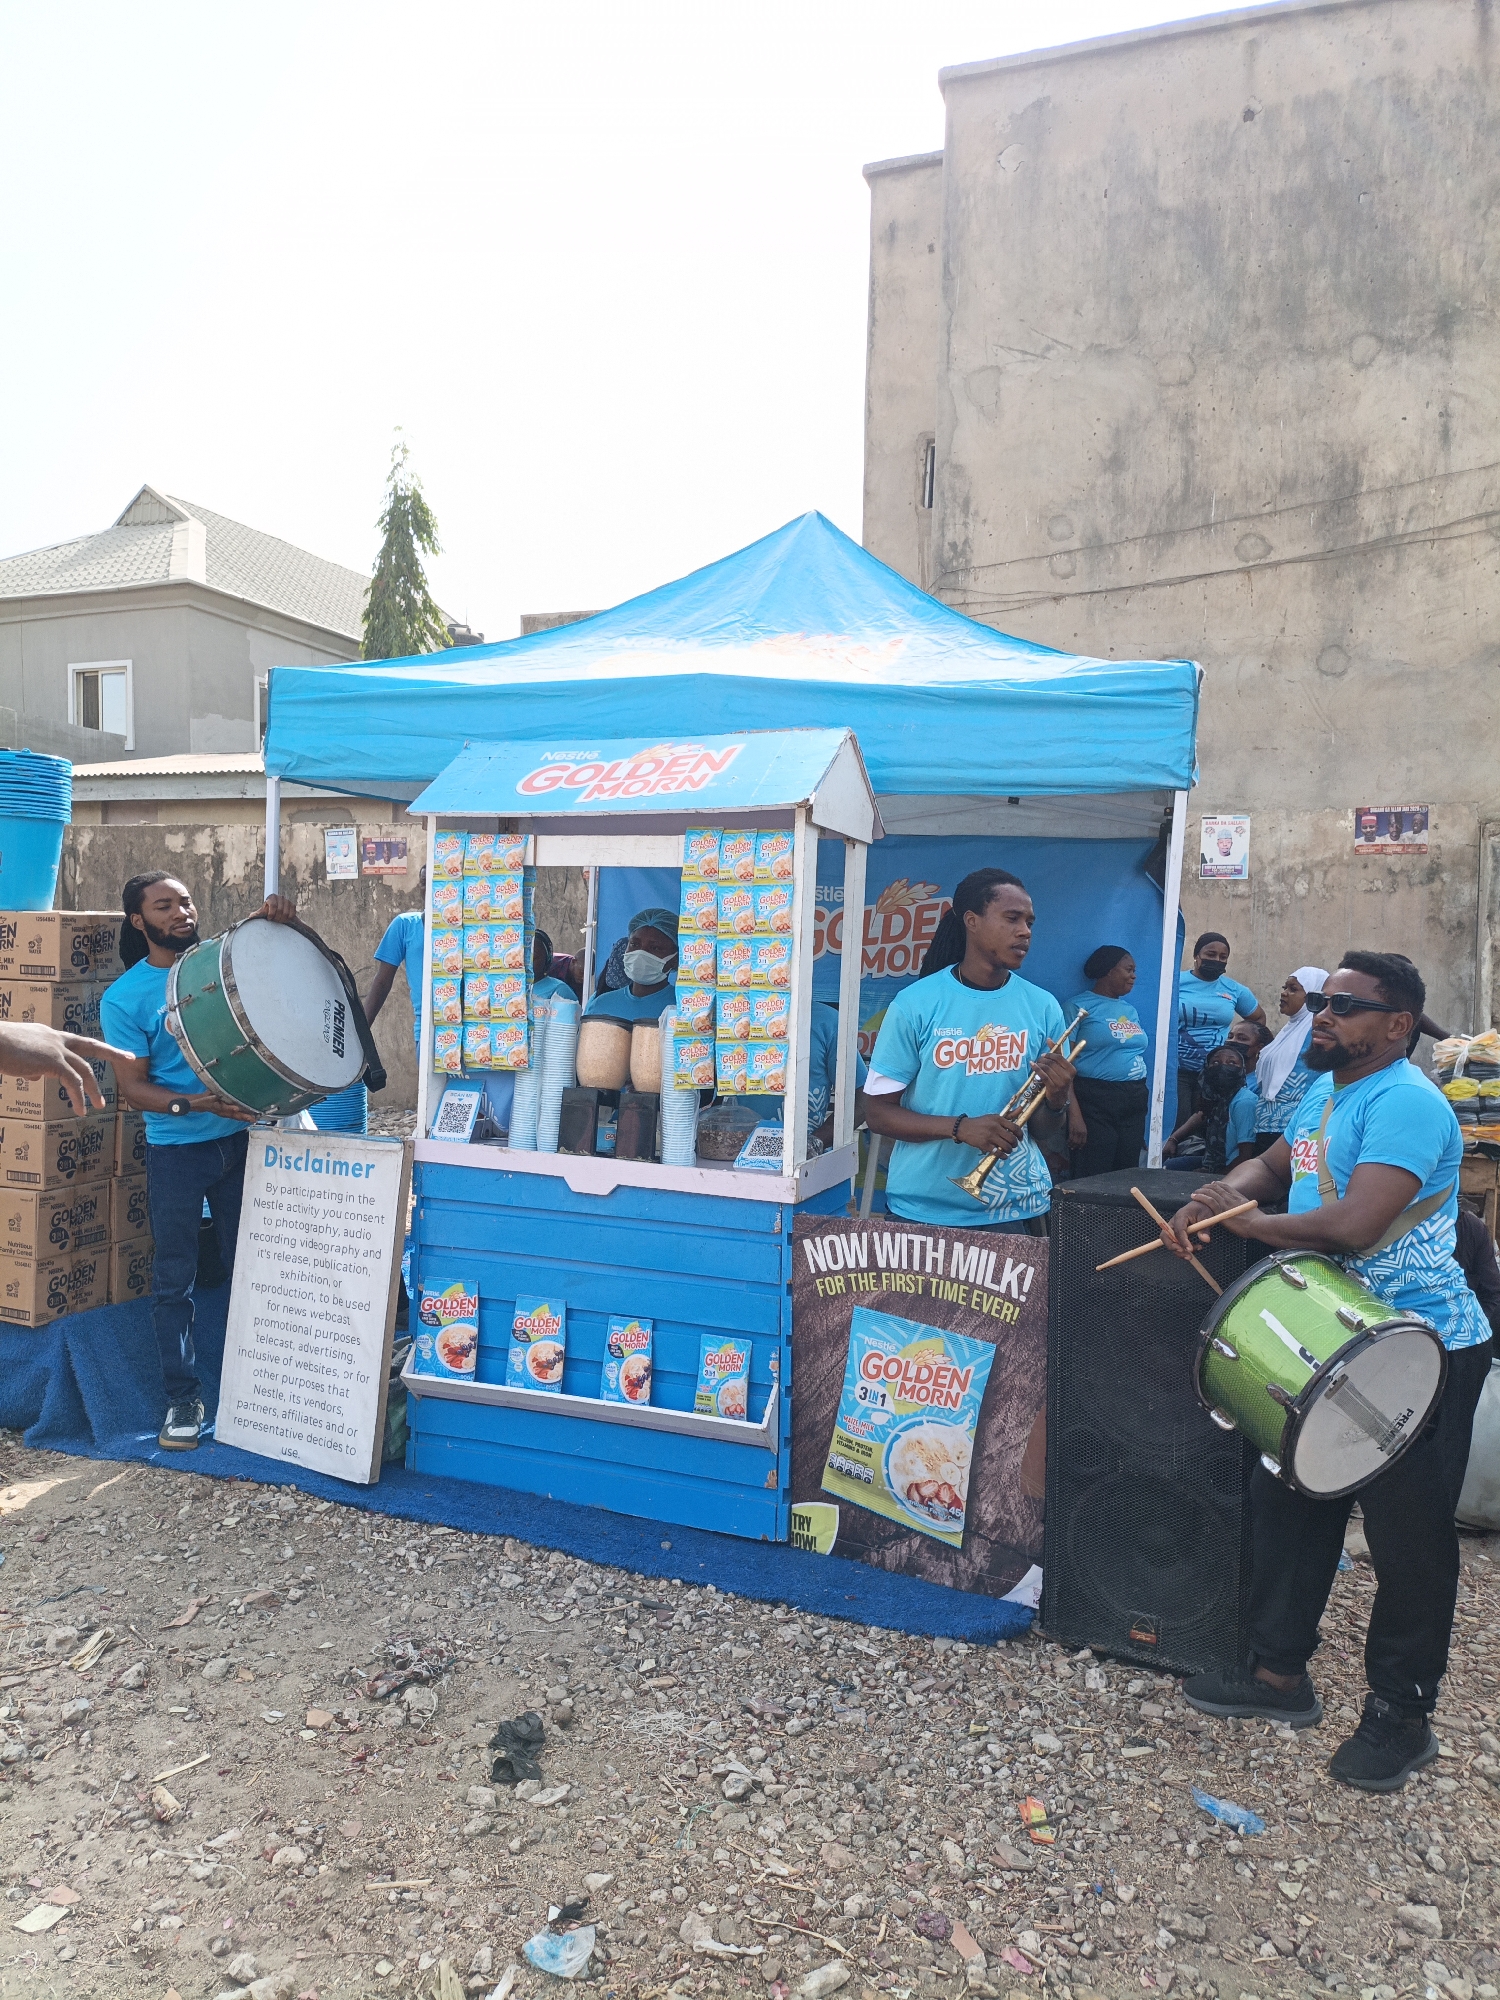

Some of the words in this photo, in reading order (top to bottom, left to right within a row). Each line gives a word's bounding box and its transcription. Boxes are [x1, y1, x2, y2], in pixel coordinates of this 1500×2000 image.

[522, 747, 738, 792] GOLDEN
[540, 751, 600, 761] Nestlé
[583, 773, 709, 799] MORN
[73, 928, 115, 950] GOLDEN
[333, 999, 345, 1058] PREMIER
[935, 1032, 1025, 1066] GOLDEN
[968, 1054, 1020, 1073] MORN
[6, 1106, 23, 1114] Family
[15, 1100, 41, 1108] Nutritious
[60, 1128, 104, 1156] GOLDEN
[264, 1145, 375, 1179] Disclaimer
[266, 1183, 278, 1194] By
[280, 1185, 343, 1203] participating
[345, 1192, 355, 1202] in
[358, 1195, 376, 1205] the
[51, 1196, 97, 1227] GOLDEN
[253, 1198, 284, 1211] Nestle
[287, 1202, 320, 1218] activity
[323, 1207, 342, 1220] you
[344, 1212, 385, 1225] consent
[263, 1217, 273, 1225] to
[275, 1218, 341, 1237] photography,
[344, 1228, 372, 1240] audio
[250, 1231, 296, 1248] recording
[300, 1238, 360, 1260] videography
[363, 1248, 381, 1259] and
[257, 1248, 270, 1259] it's
[273, 1251, 310, 1267] release,
[313, 1257, 371, 1277] publication,
[803, 1232, 868, 1273] NOW
[873, 1232, 945, 1275] WITH
[951, 1242, 1034, 1302] MILK!
[49, 1261, 96, 1293] GOLDEN
[280, 1270, 331, 1287] exhibition,
[333, 1279, 342, 1288] or
[251, 1281, 316, 1303] reproduction,
[320, 1292, 329, 1303] to
[332, 1294, 344, 1306] be
[346, 1297, 370, 1312] used
[422, 1296, 477, 1312] GOLDEN
[816, 1275, 846, 1297] FOR
[848, 1273, 878, 1291] THE
[882, 1272, 925, 1295] FIRST
[930, 1278, 968, 1305] TIME
[971, 1290, 1020, 1325] EVER!
[267, 1300, 280, 1312] for
[283, 1304, 306, 1317] news
[310, 1308, 351, 1325] webcast
[515, 1316, 560, 1329] GOLDEN
[254, 1316, 312, 1336] promotional
[315, 1325, 361, 1345] purposes
[611, 1331, 649, 1344] GOLDEN
[256, 1334, 295, 1350] telecast,
[299, 1343, 356, 1364] advertising,
[705, 1353, 744, 1366] GOLDEN
[238, 1346, 280, 1364] inclusive
[283, 1356, 294, 1367] of
[296, 1359, 339, 1378] websites,
[344, 1370, 353, 1379] or
[357, 1372, 370, 1384] for
[862, 1352, 972, 1392] GOLDEN
[253, 1368, 279, 1381] other
[282, 1373, 324, 1392] purposes
[328, 1384, 349, 1398] that
[897, 1382, 961, 1408] MORN
[254, 1384, 285, 1402] Nestle,
[289, 1392, 300, 1405] its
[304, 1397, 344, 1417] vendors,
[237, 1400, 278, 1418] partners,
[282, 1409, 322, 1428] affiliates
[326, 1419, 344, 1434] and
[347, 1426, 358, 1438] or
[861, 1422, 874, 1432] MILK
[233, 1416, 303, 1441] representative
[306, 1433, 342, 1452] decides
[346, 1444, 356, 1456] to
[281, 1447, 300, 1459] use.
[793, 1513, 811, 1532] TRY
